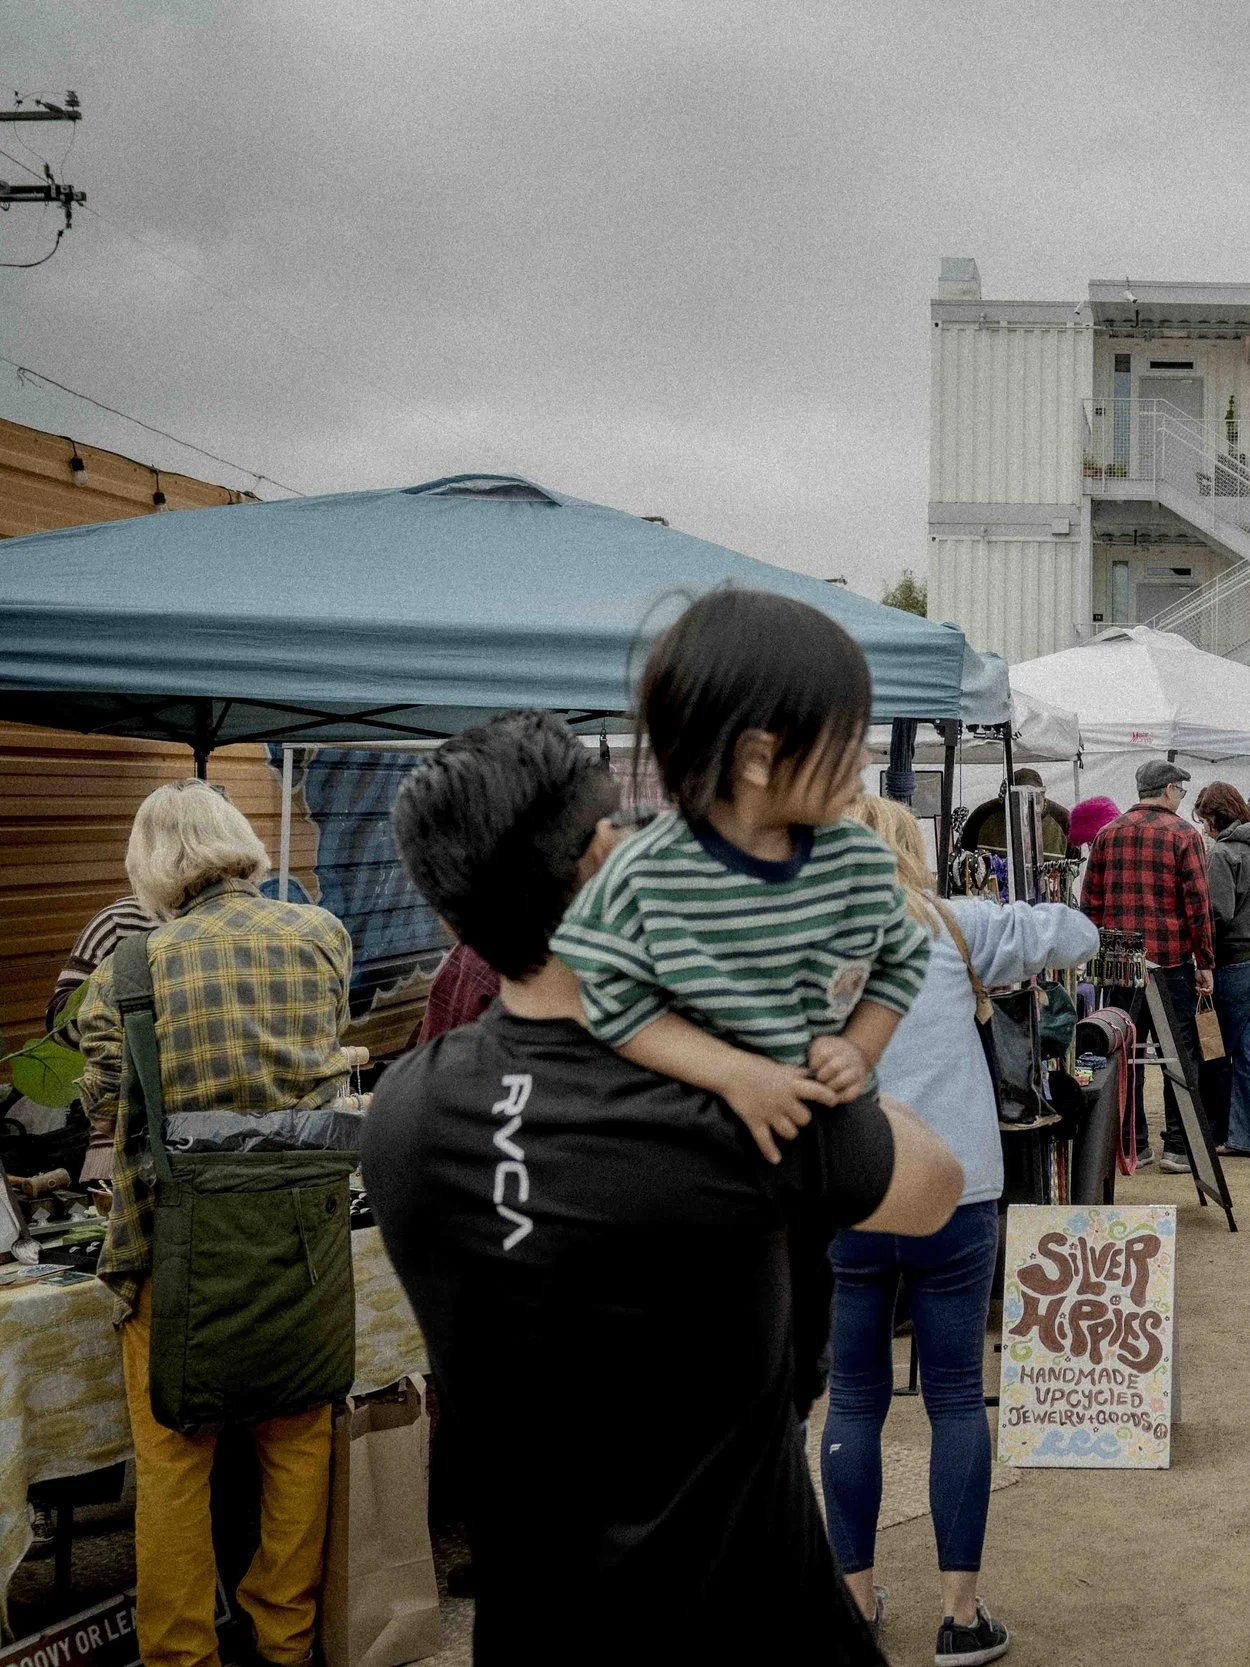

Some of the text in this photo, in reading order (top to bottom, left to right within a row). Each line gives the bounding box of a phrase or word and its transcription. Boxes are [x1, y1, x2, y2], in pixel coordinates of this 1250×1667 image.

[491, 1073, 534, 1251] RVCA
[1020, 1365, 1141, 1389] HANDMADE
[75, 1624, 104, 1654] OR
